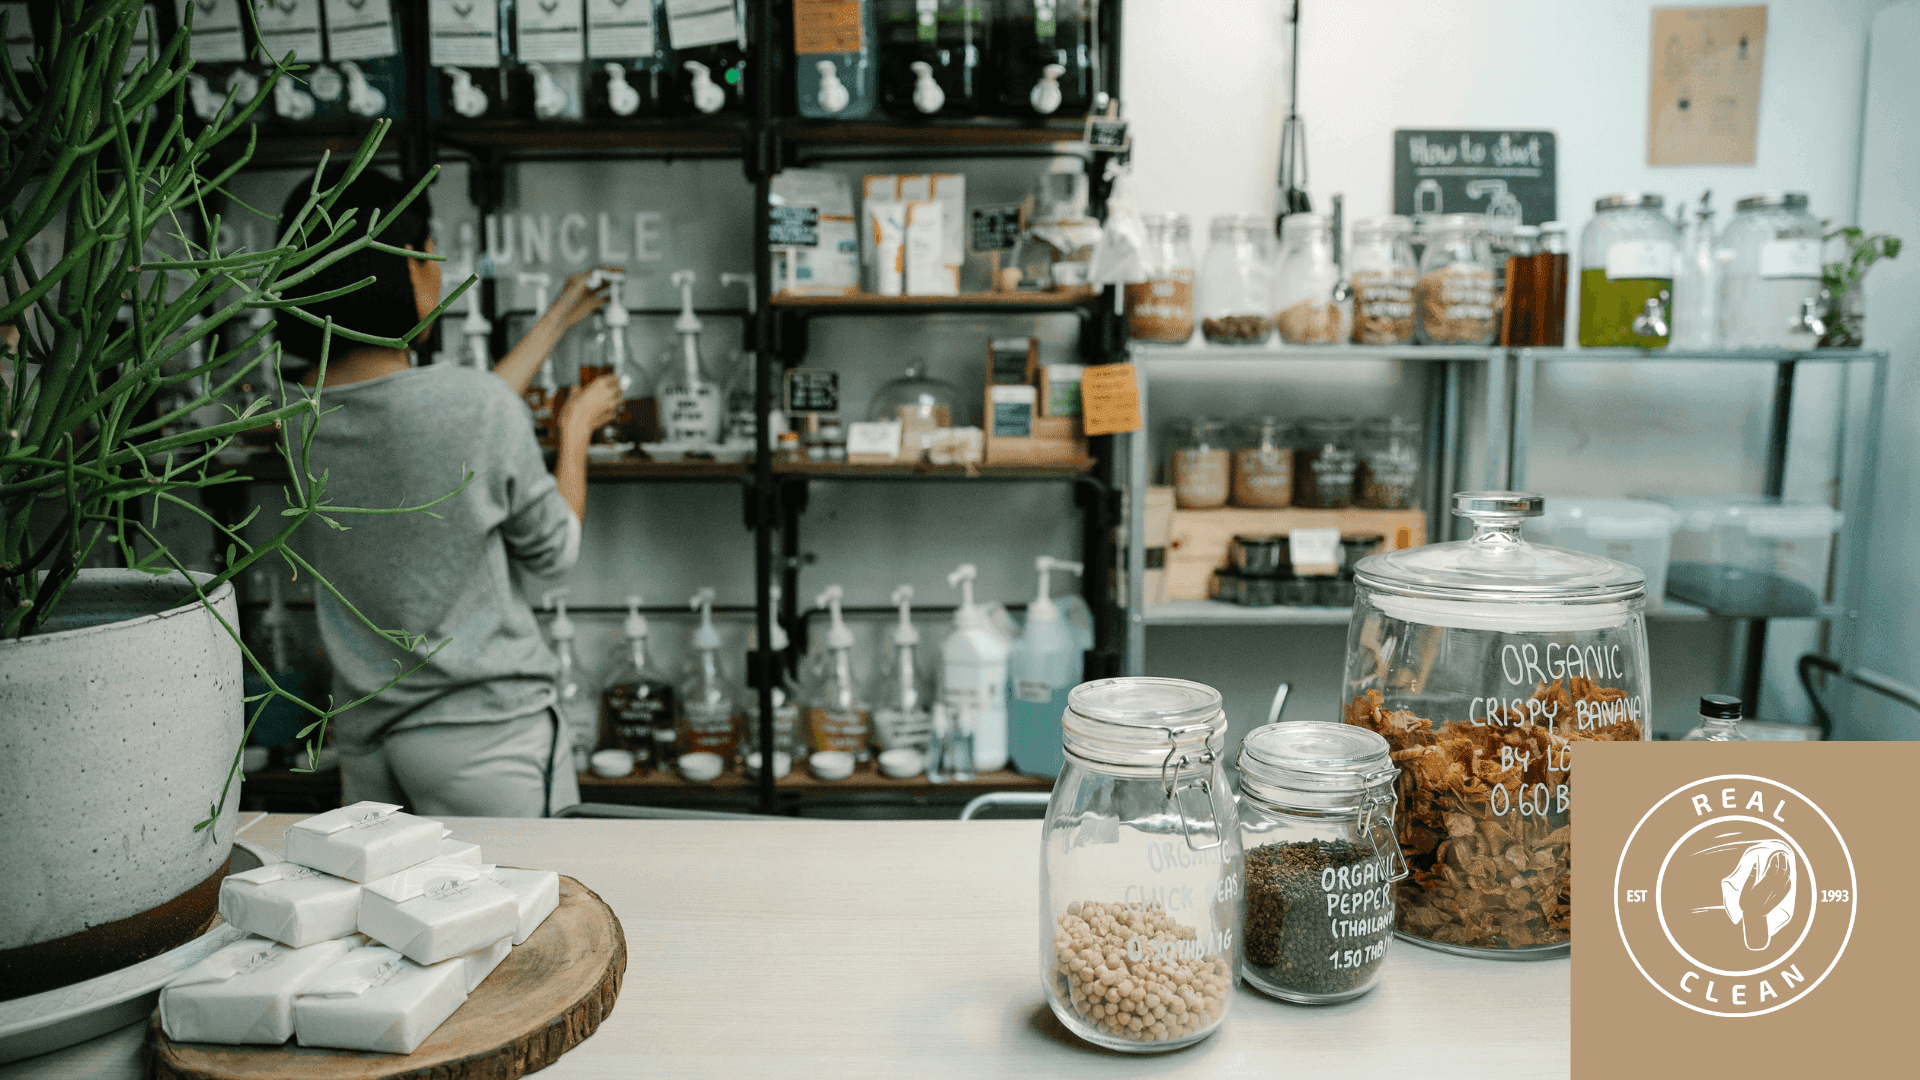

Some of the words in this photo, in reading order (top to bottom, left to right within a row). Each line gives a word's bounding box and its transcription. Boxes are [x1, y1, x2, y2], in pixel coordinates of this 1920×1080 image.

[1410, 133, 1457, 165] How
[1460, 132, 1486, 163] to
[1501, 642, 1623, 686] ORGANIC
[1469, 696, 1558, 734] CRISPY
[1575, 694, 1642, 731] BANANA
[1500, 745, 1530, 772] BY
[1321, 852, 1396, 892] ORGANIC
[1124, 884, 1194, 914] CHICK
[1326, 882, 1391, 917] PEPPER
